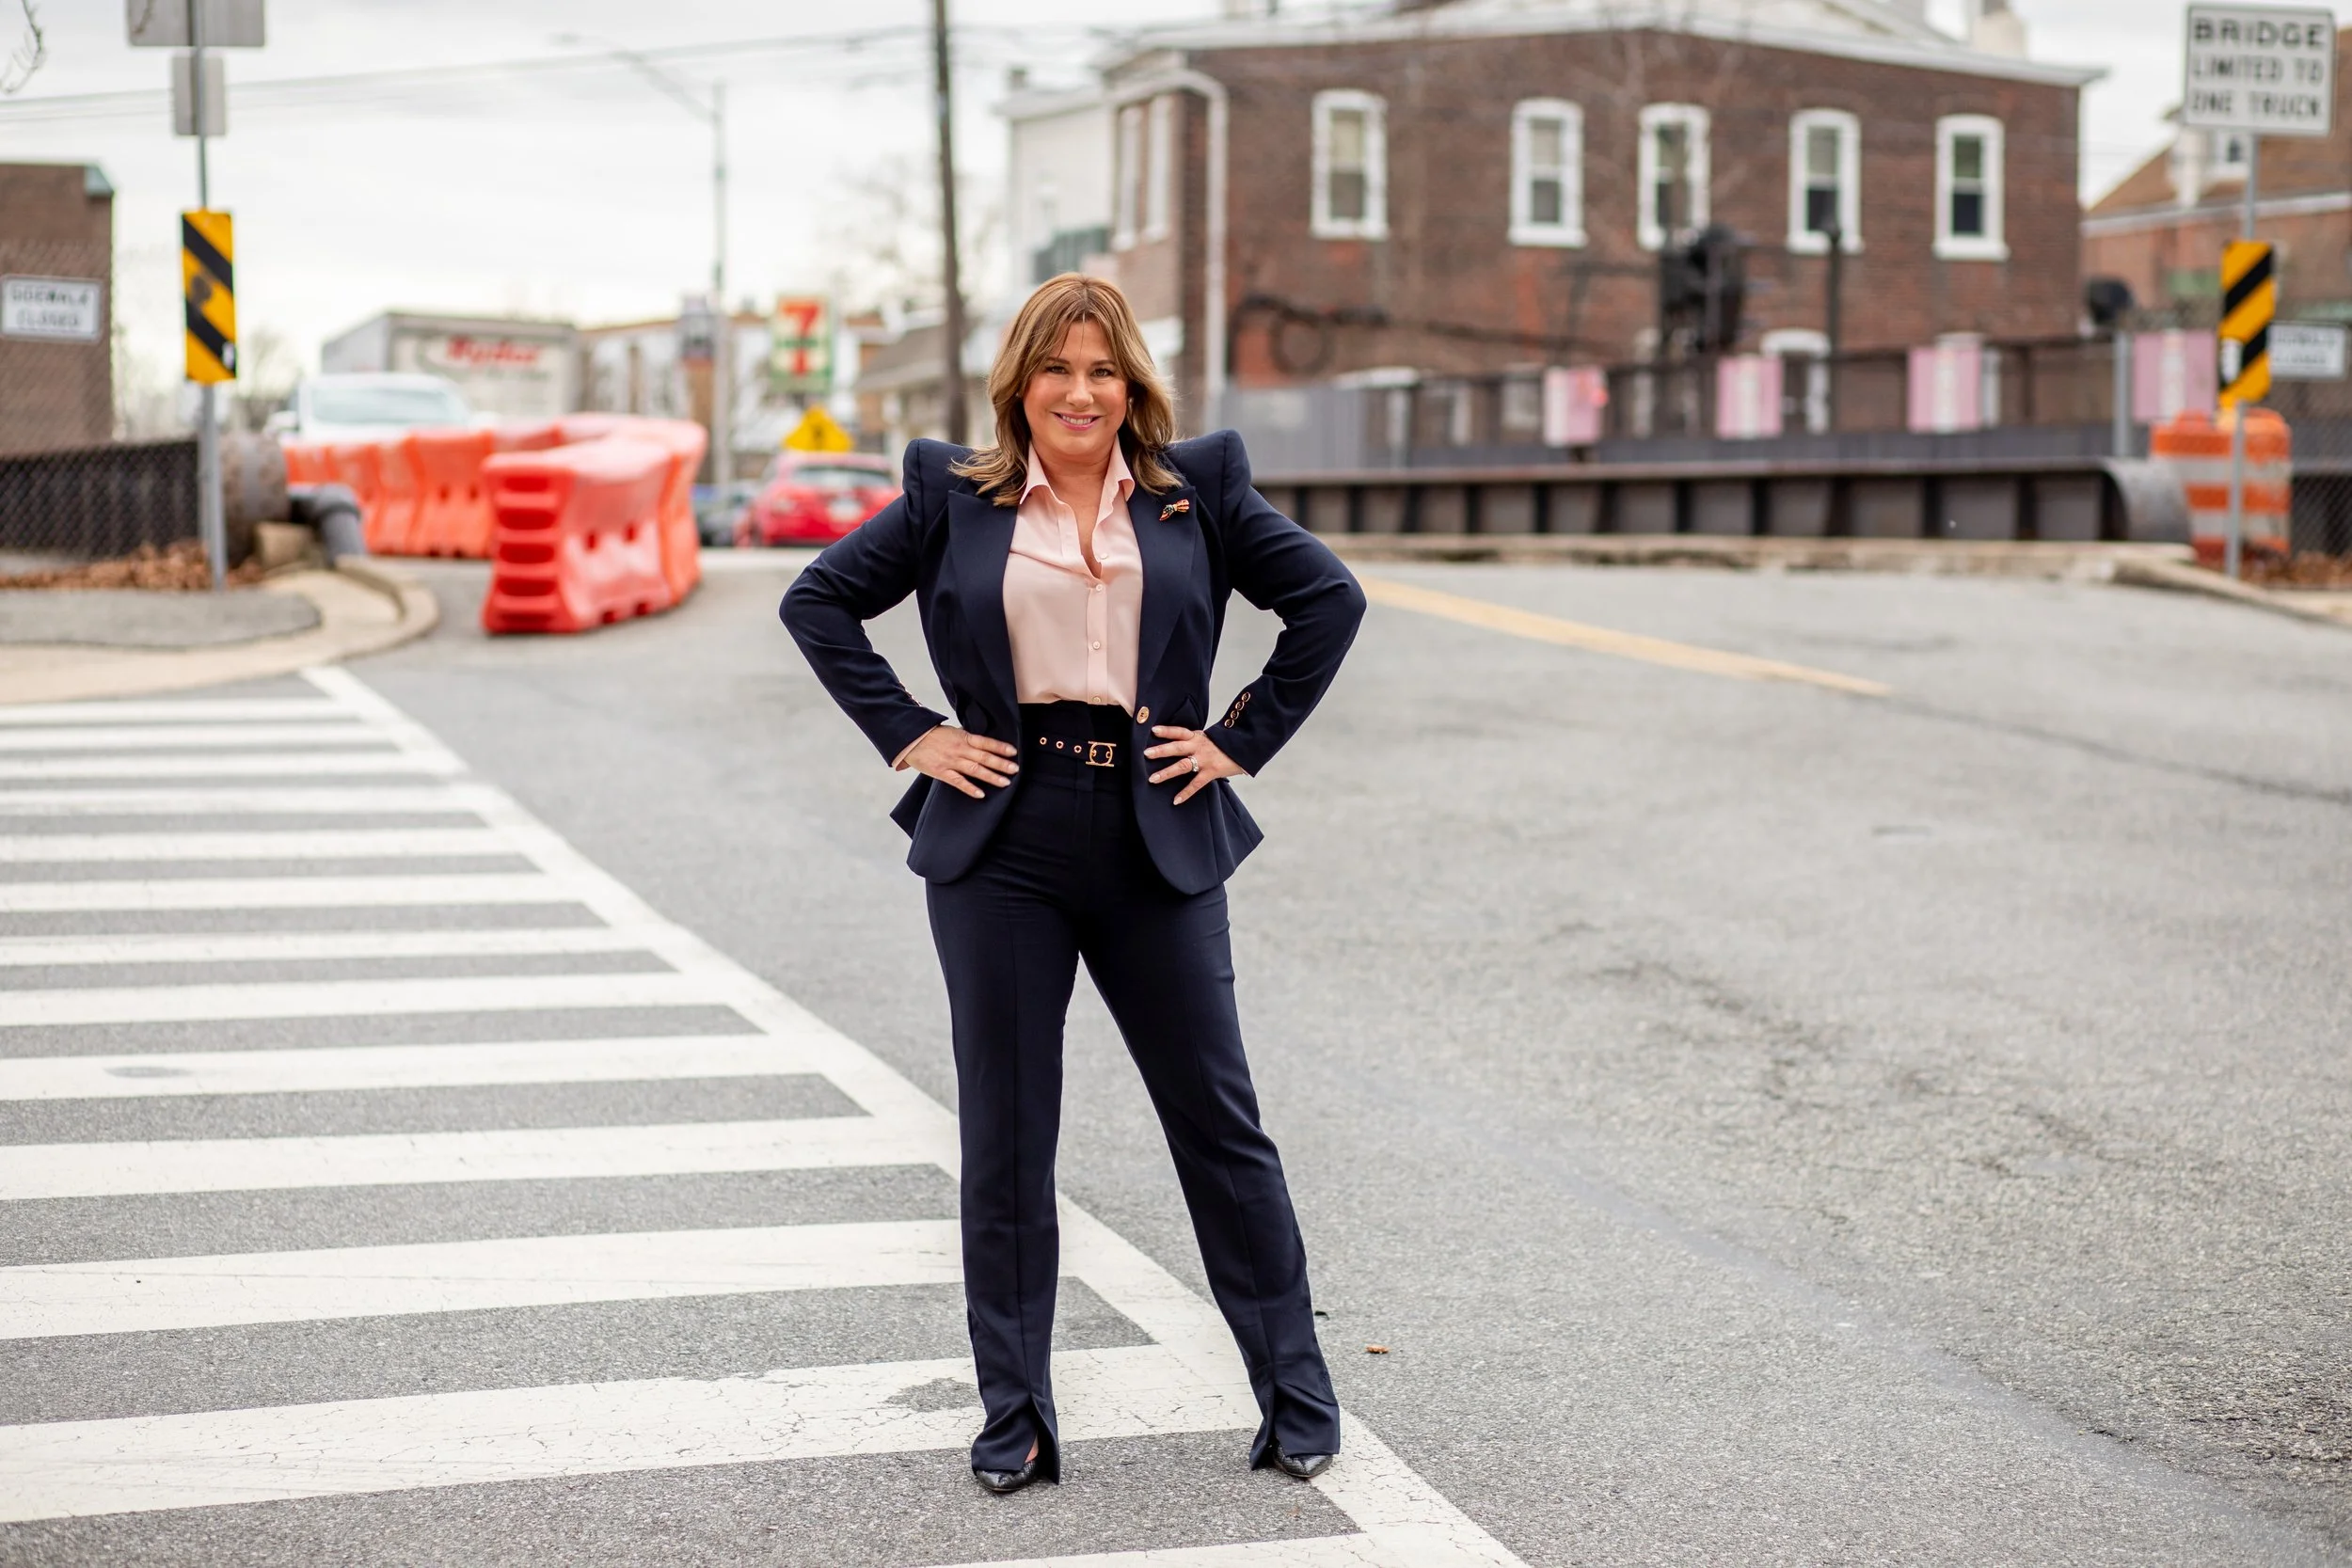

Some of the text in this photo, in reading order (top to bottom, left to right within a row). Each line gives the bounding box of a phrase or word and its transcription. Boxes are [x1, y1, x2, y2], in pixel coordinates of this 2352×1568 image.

[2193, 17, 2327, 50] BRIDGE
[2192, 53, 2325, 87] LIMITED TO
[2191, 87, 2323, 120] ONE TRUCK
